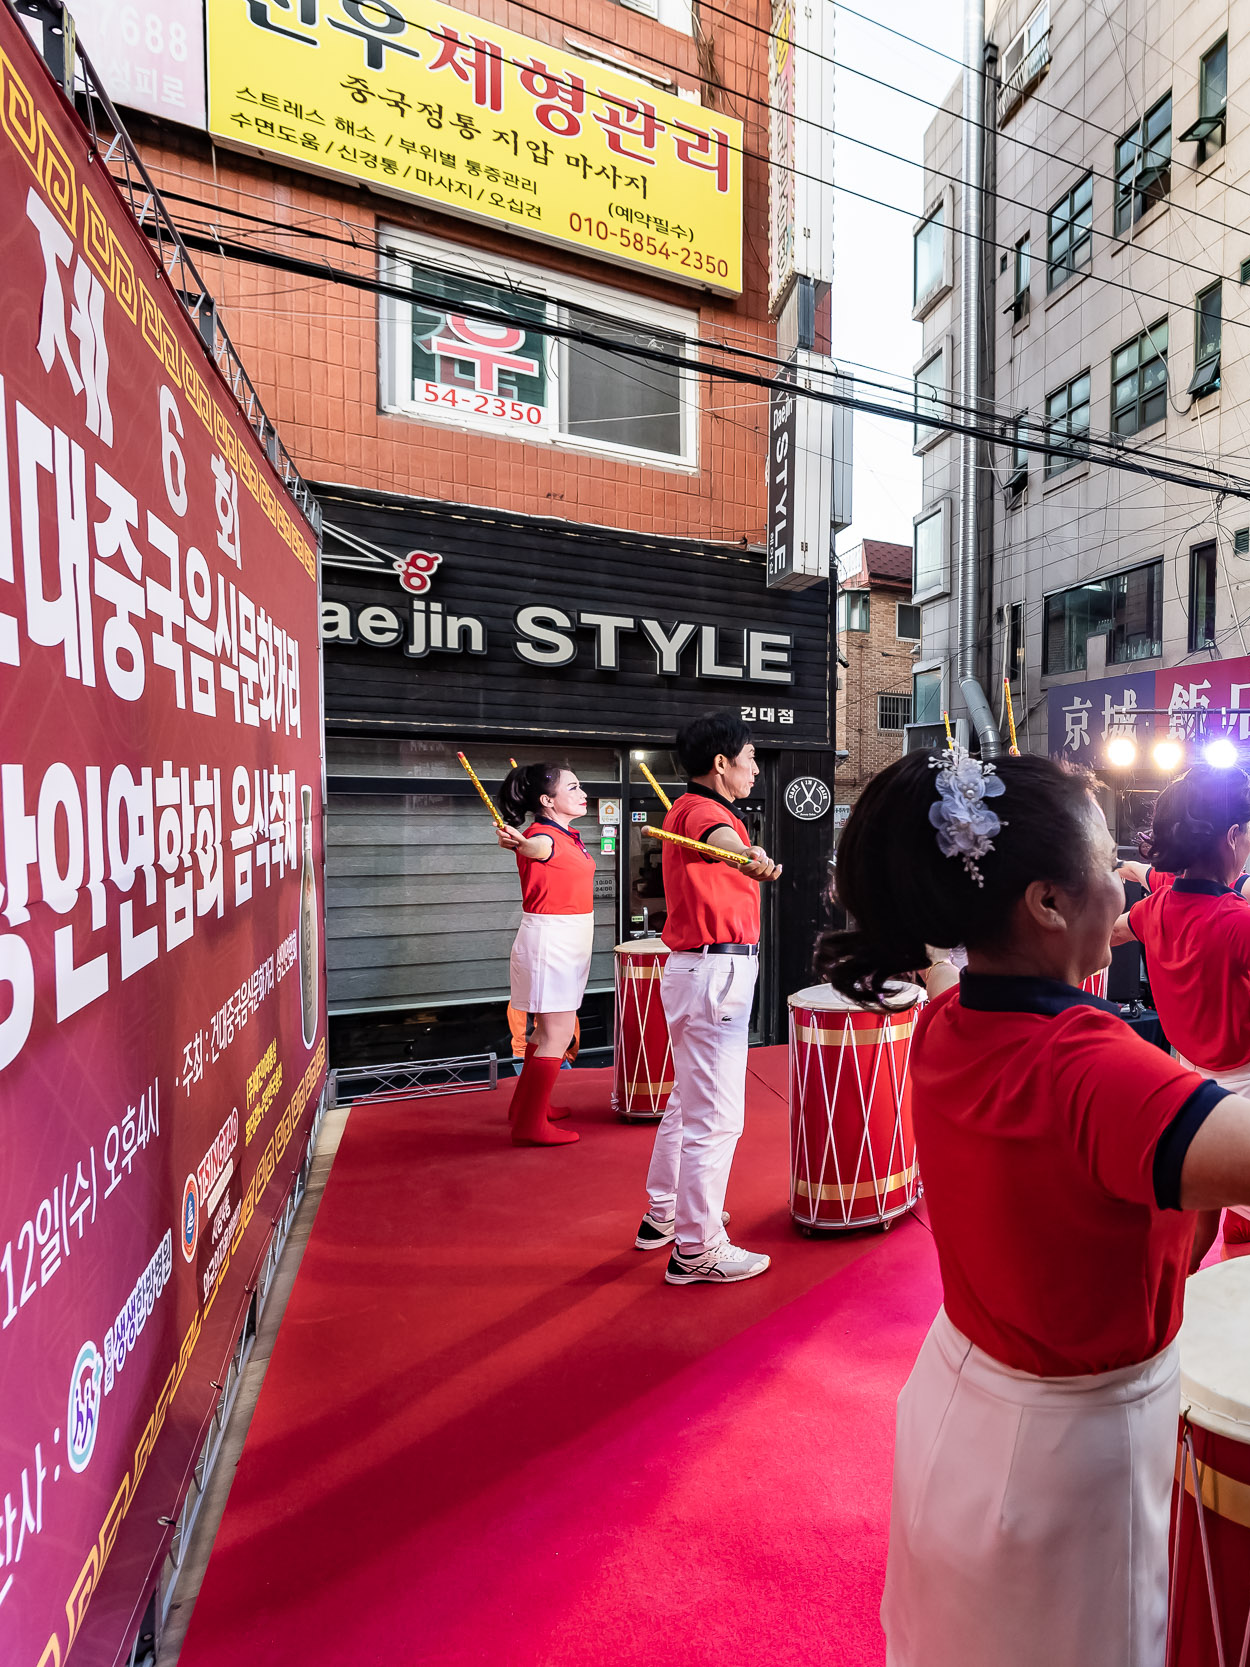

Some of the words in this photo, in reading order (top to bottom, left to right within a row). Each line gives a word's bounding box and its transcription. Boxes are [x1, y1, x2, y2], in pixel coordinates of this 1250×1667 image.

[235, 86, 327, 126] 스트레스
[335, 116, 376, 143] 해소
[398, 137, 457, 169] 부위별
[464, 158, 538, 196] 통증관리
[340, 74, 482, 141] 중국정통
[493, 129, 554, 166] 지압
[566, 153, 647, 200] 마사지
[569, 211, 729, 278] 010-5854-2350
[608, 202, 695, 243] (예약필수)
[26, 186, 113, 448] 제
[159, 384, 188, 517] 6
[211, 453, 242, 571] 회
[424, 382, 542, 425] 54-2350
[773, 396, 793, 432] Daejin
[774, 431, 788, 575] STYLE
[515, 606, 792, 683] STYLE
[740, 707, 795, 725] 건대점
[231, 765, 297, 908] 음식축제
[183, 1028, 203, 1097] 주최
[0, 1146, 97, 1330] 12일(수)
[104, 1076, 160, 1200] 오후4시
[198, 1107, 239, 1207] TSINGTAO
[114, 1228, 173, 1373] 생생한방병원
